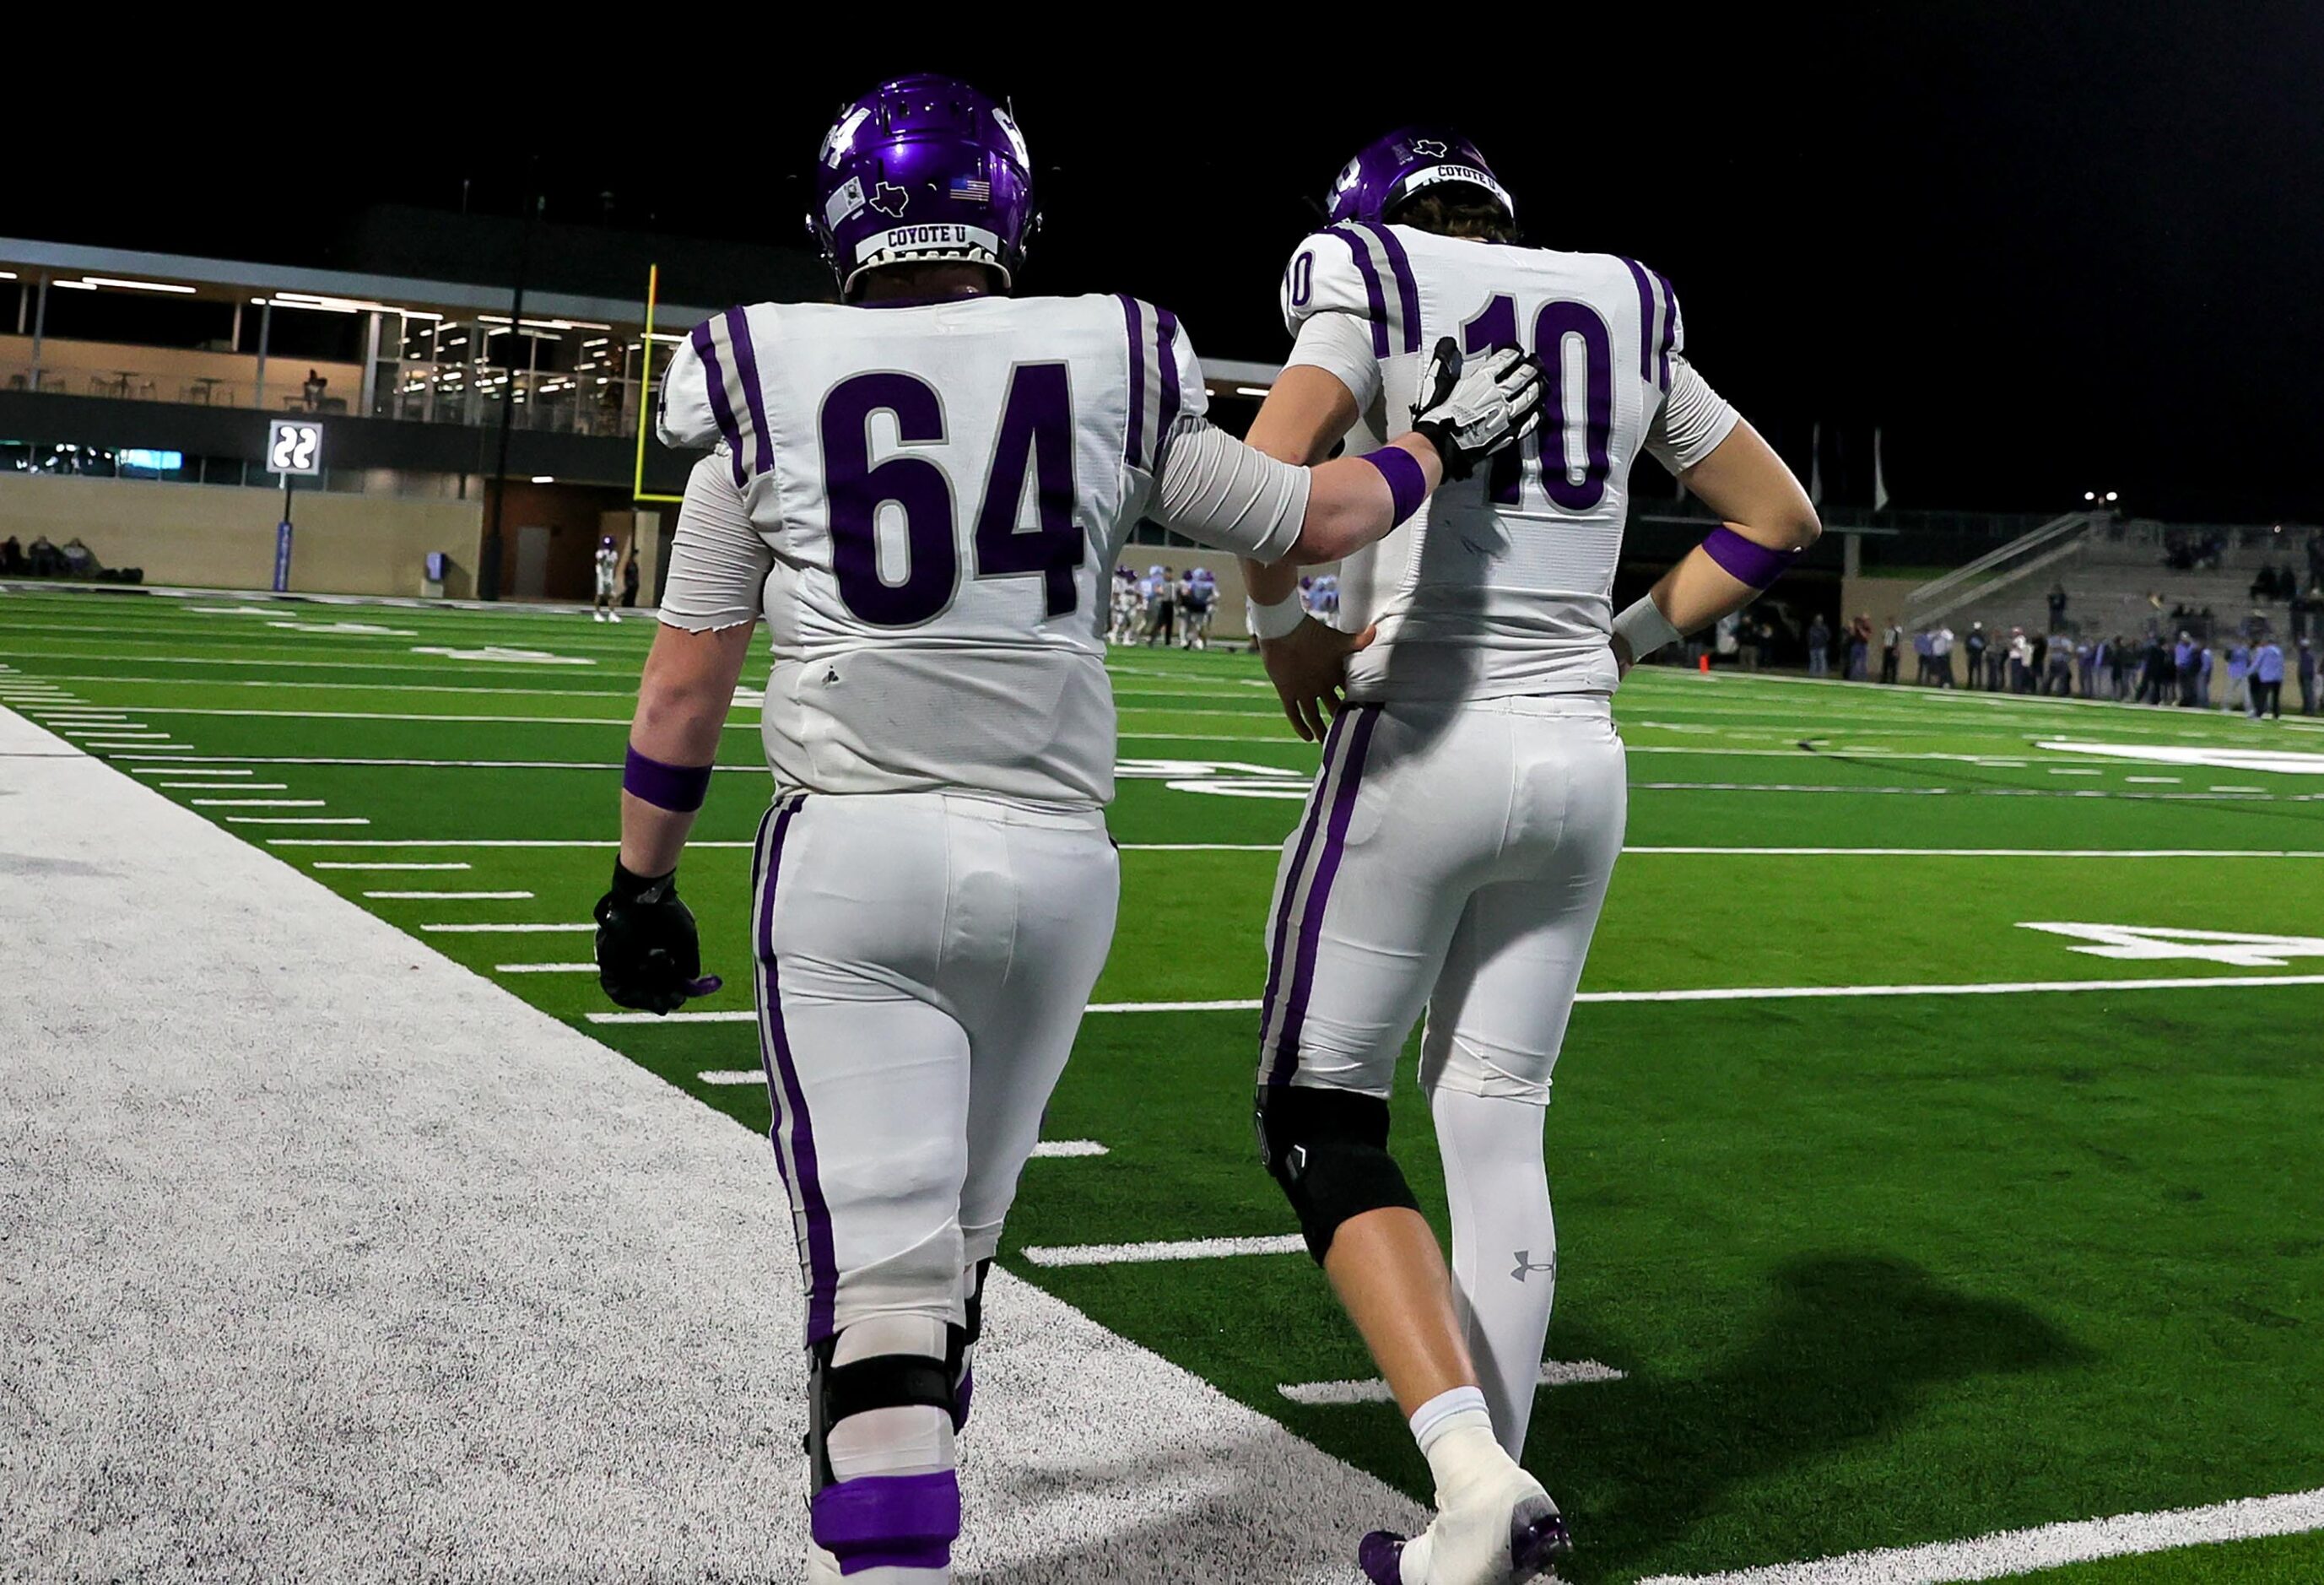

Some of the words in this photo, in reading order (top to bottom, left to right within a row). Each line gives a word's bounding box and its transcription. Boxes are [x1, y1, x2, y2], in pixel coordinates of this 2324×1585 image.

[1437, 165, 1487, 184] COYOTE
[1488, 176, 1496, 190] U
[887, 225, 950, 248] COYOTE
[954, 225, 966, 243] U
[1458, 289, 1617, 514] 10
[273, 425, 317, 469] 22
[816, 359, 1085, 631] 64
